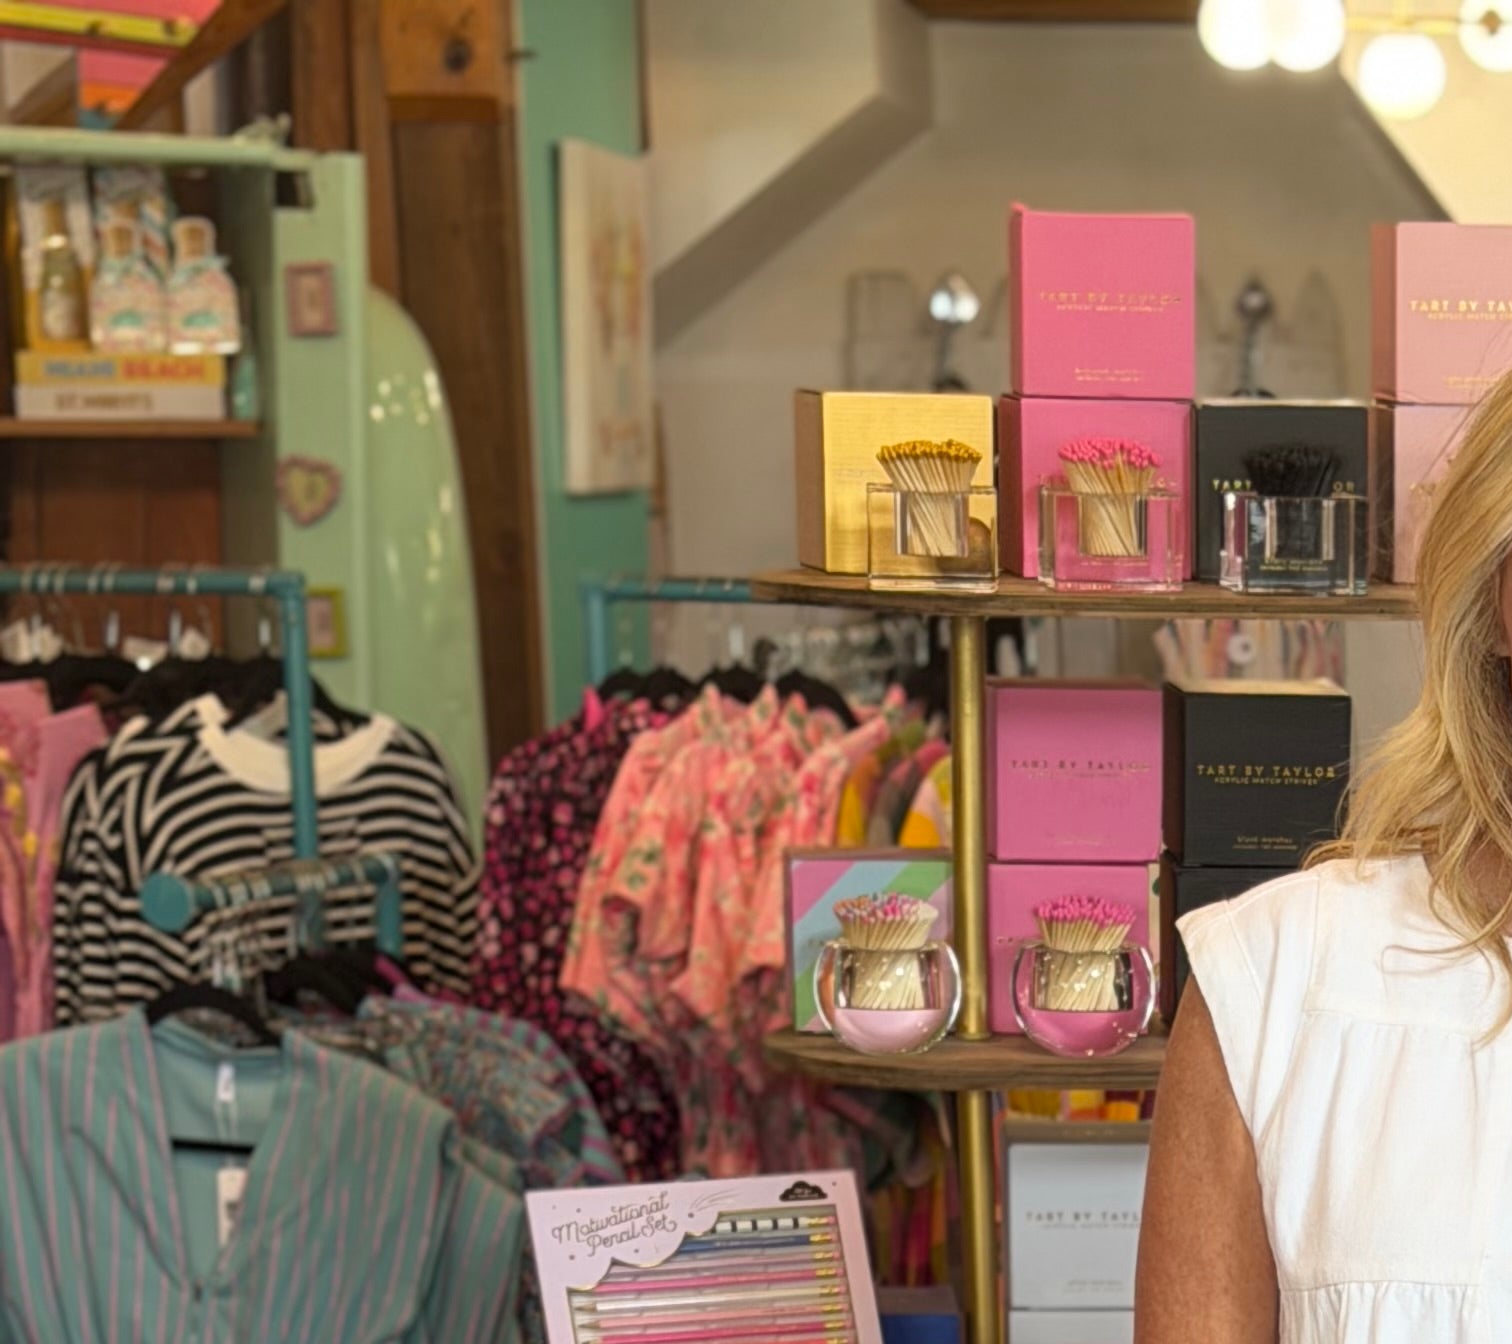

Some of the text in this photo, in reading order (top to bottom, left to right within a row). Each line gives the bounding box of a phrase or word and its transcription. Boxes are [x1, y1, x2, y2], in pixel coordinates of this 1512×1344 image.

[1409, 300, 1449, 312] TART
[1458, 300, 1479, 312] BY
[1212, 480, 1253, 491] TART
[1197, 765, 1336, 778] TART BY TAYLOR
